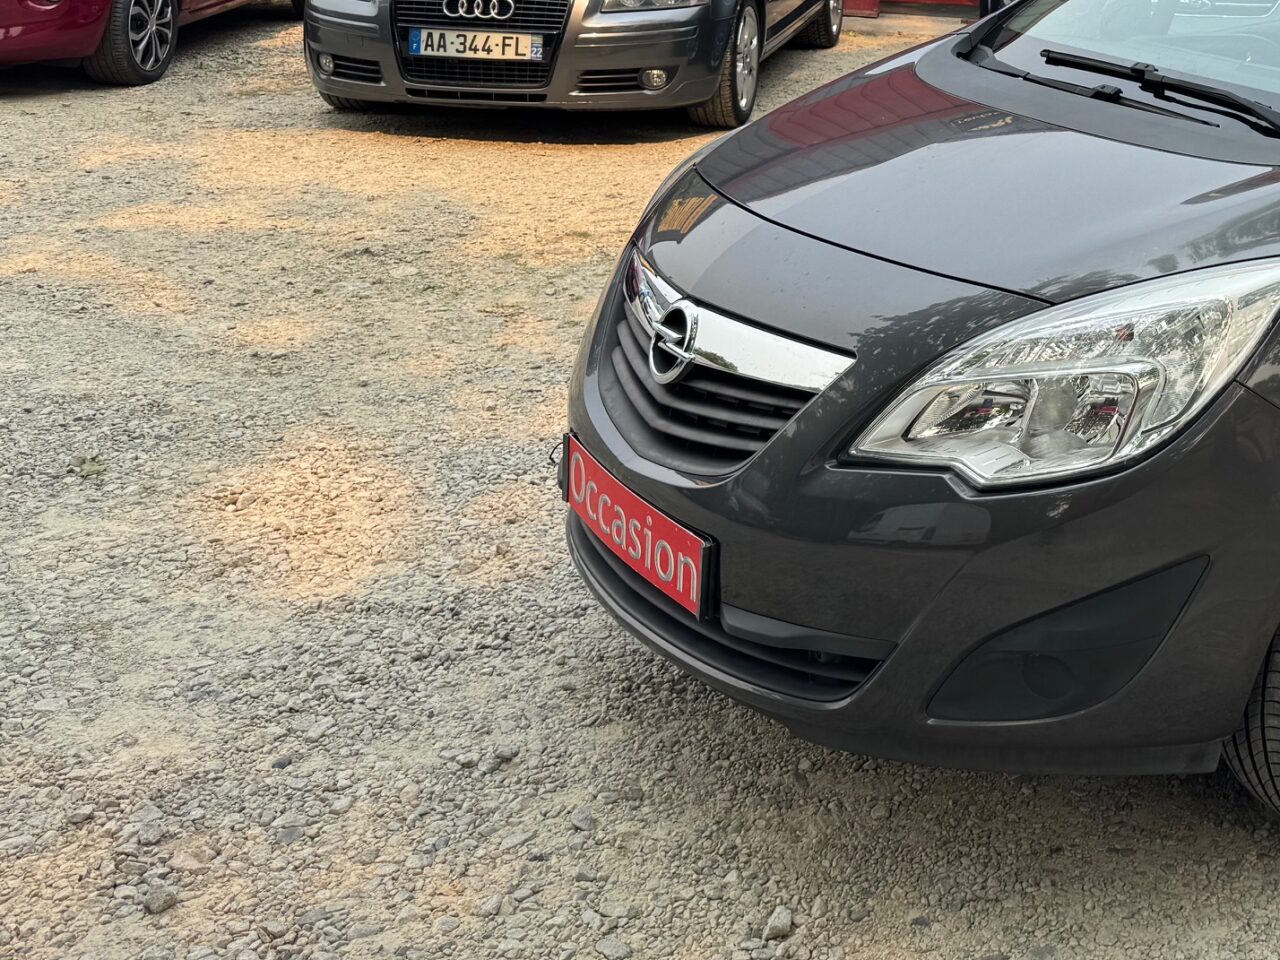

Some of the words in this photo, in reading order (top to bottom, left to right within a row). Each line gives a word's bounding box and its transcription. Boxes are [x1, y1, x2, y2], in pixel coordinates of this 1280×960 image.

[424, 32, 526, 57] AA-344-FL
[531, 47, 543, 58] 22
[570, 451, 699, 603] Occasion
